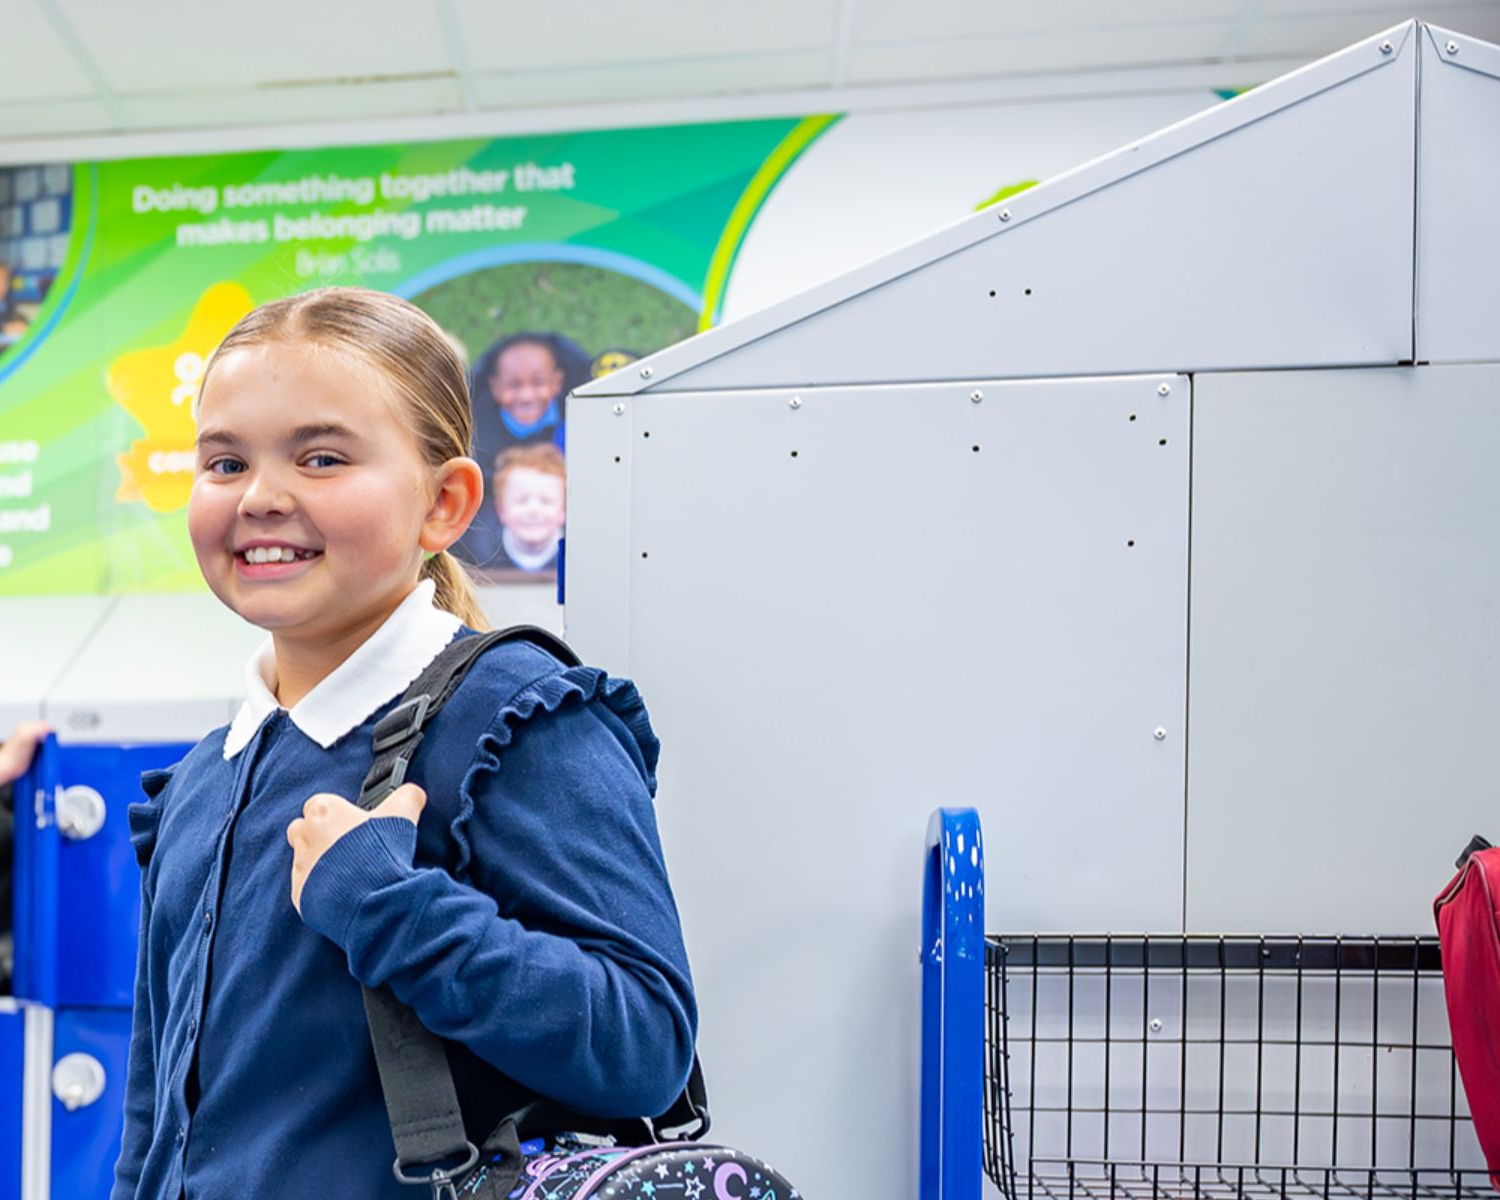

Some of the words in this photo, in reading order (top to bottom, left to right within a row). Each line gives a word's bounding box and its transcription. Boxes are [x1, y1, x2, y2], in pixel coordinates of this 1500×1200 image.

[132, 182, 218, 214] Doing
[223, 174, 375, 208] something
[380, 167, 507, 203] together
[513, 161, 576, 192] that
[176, 215, 269, 247] makes
[274, 207, 420, 241] belonging
[426, 204, 526, 233] matter
